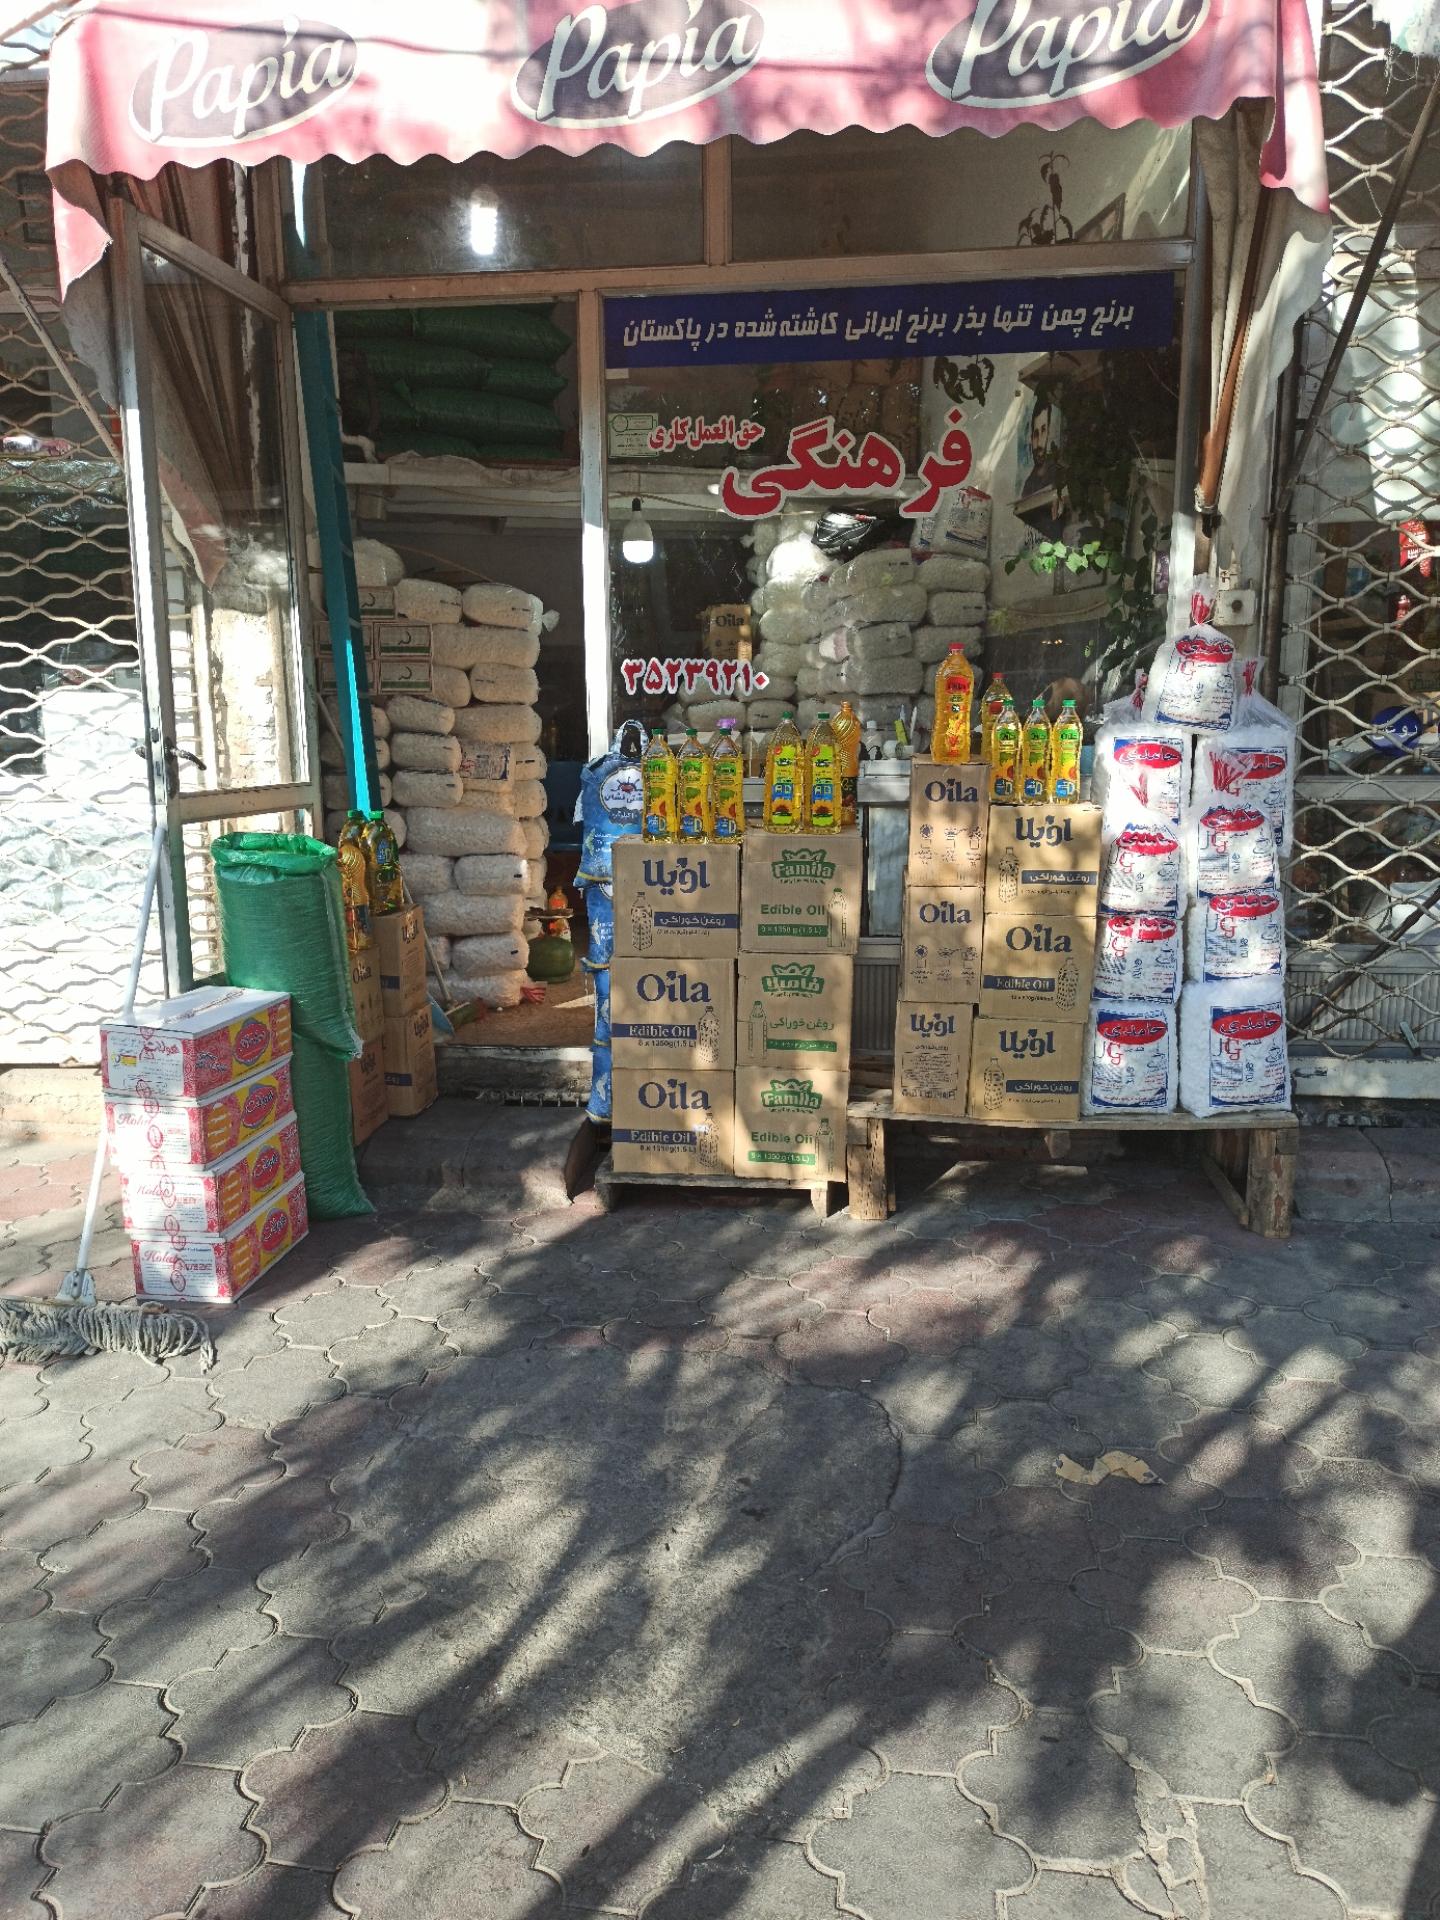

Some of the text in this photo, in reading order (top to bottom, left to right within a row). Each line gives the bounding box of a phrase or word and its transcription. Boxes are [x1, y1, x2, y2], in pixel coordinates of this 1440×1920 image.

[535, 0, 761, 121] Papia
[951, 0, 1199, 100] Papia
[150, 14, 356, 142] Papia
[705, 322, 728, 343] در
[845, 309, 903, 341] ایرانی
[906, 307, 947, 344] برنج
[953, 305, 987, 336] بذر
[993, 303, 1033, 333] تنها
[1041, 304, 1086, 338] چمن
[1091, 300, 1135, 336] برنج
[623, 318, 701, 352] پاکستان
[687, 415, 735, 450] العمل
[734, 419, 766, 450] حق
[718, 404, 973, 518] فرهنگی
[621, 657, 770, 696] ۳۵۲۳۹۲۱۰
[925, 779, 977, 802] Oila
[1016, 815, 1074, 848] اویلا
[642, 858, 710, 895] اویلا
[774, 861, 831, 878] Famila
[660, 914, 726, 926] روغن خوراکی
[761, 904, 825, 915] Edible Oil
[919, 901, 972, 924] Oila
[1005, 924, 1073, 953] Oila
[637, 970, 711, 1003] Oila
[766, 977, 820, 991] فامیلا
[1033, 980, 1050, 990] Oil
[629, 1025, 690, 1037] Edible Oil
[770, 1016, 835, 1030] روغن خوراکی
[1103, 1022, 1166, 1039] حامدی
[1219, 1014, 1281, 1034] حامدی
[1000, 1029, 1056, 1059] اویلا
[638, 1078, 711, 1110] Oila
[763, 1091, 819, 1108] Famila
[1014, 1083, 1073, 1092] روغن خوراکی
[631, 1130, 690, 1143] Edible Oil
[751, 1131, 813, 1144] Edible Oil
